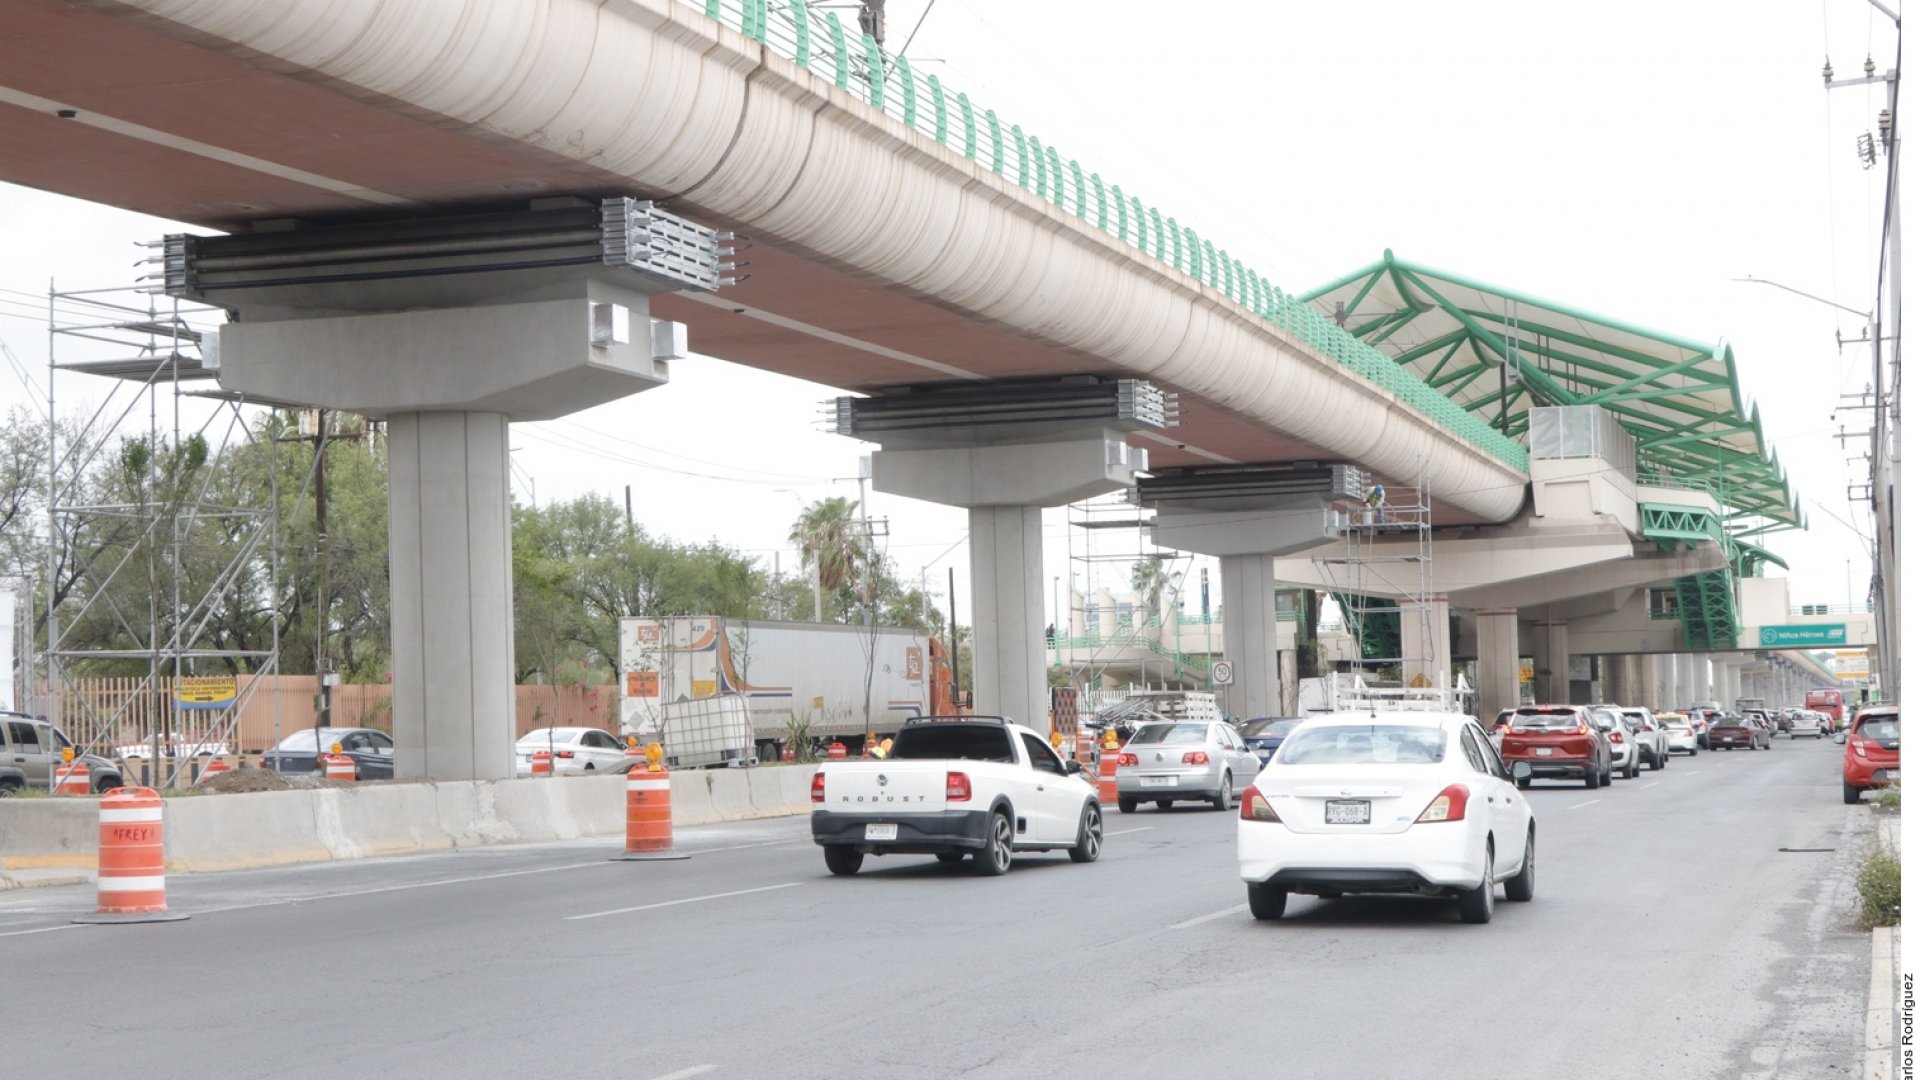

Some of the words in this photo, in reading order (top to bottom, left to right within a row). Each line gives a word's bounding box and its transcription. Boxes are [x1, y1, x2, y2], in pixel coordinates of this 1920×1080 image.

[1779, 631, 1799, 639] Niños
[1800, 630, 1824, 639] Héroes
[1218, 666, 1228, 676] 50
